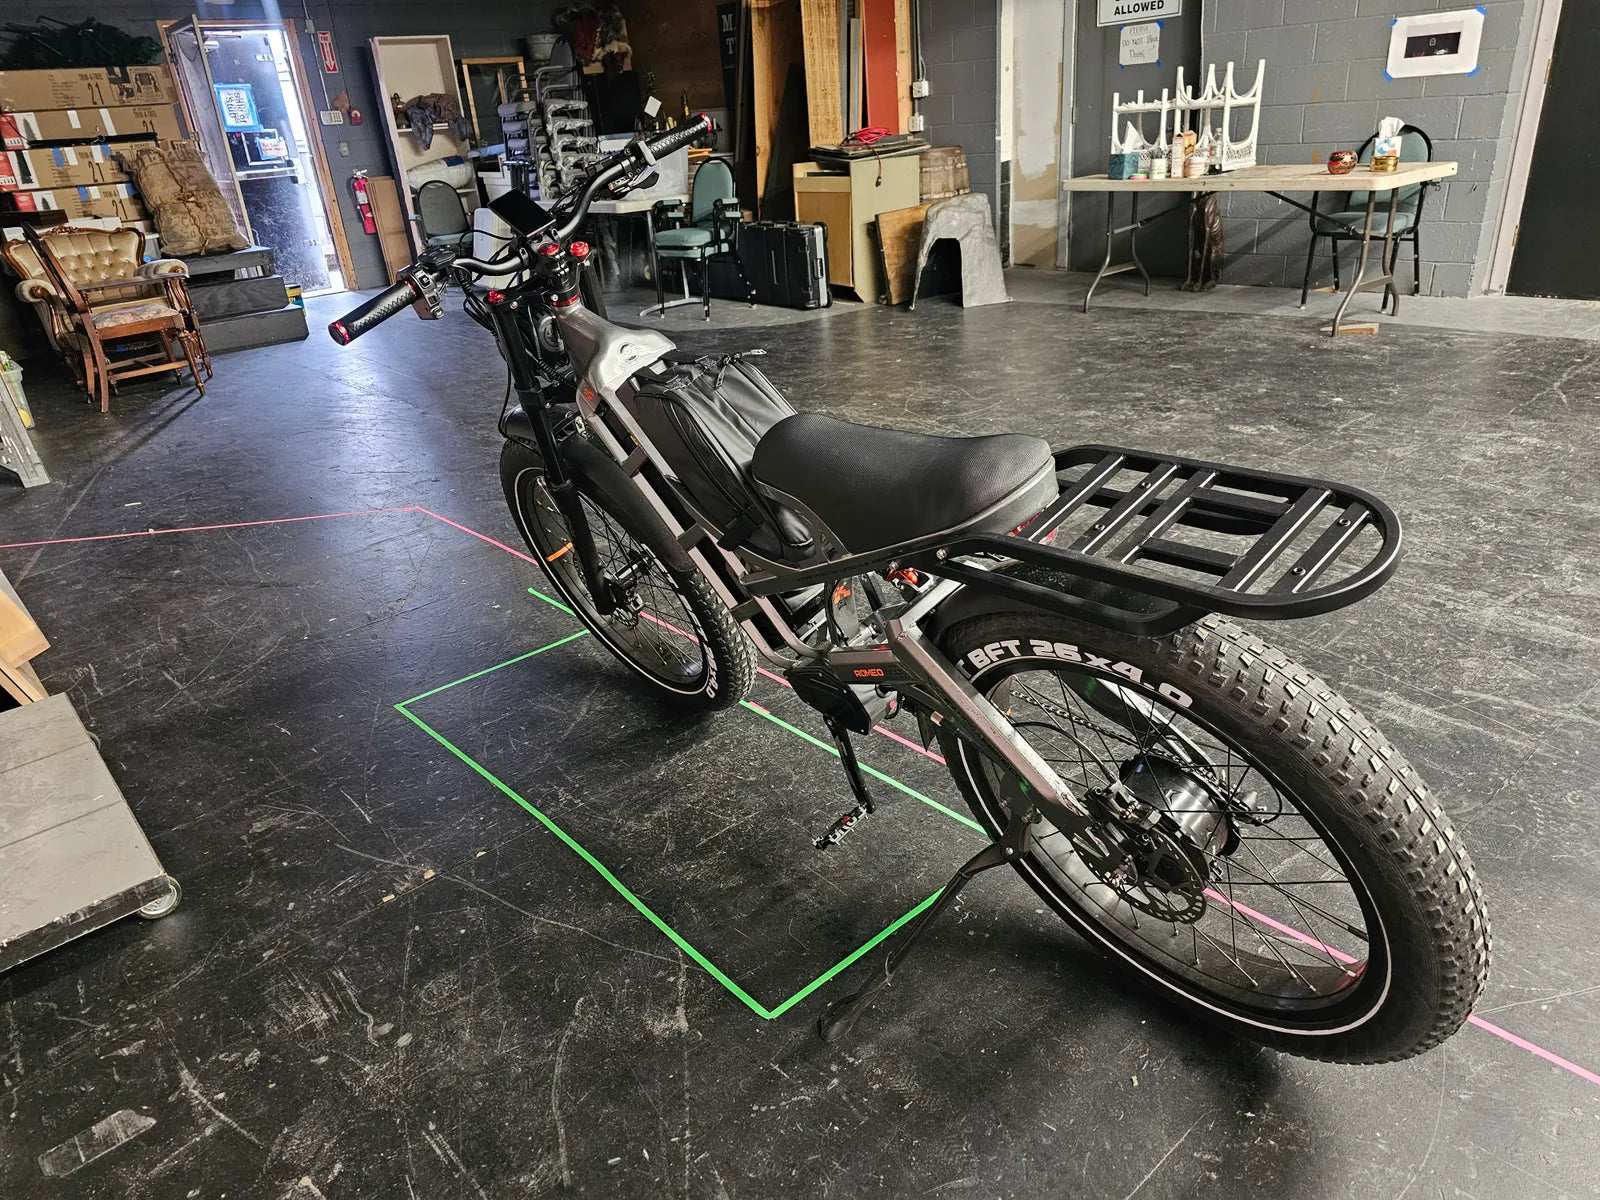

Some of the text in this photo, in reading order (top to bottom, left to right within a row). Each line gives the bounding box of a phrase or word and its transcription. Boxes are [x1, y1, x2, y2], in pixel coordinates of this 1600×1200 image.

[1114, 0, 1164, 16] ALLOWED
[721, 13, 736, 32] M
[88, 82, 105, 106] 21
[88, 161, 105, 183] 21
[112, 199, 129, 221] 21
[967, 639, 1021, 670] BFT
[853, 668, 885, 677] ROMEO
